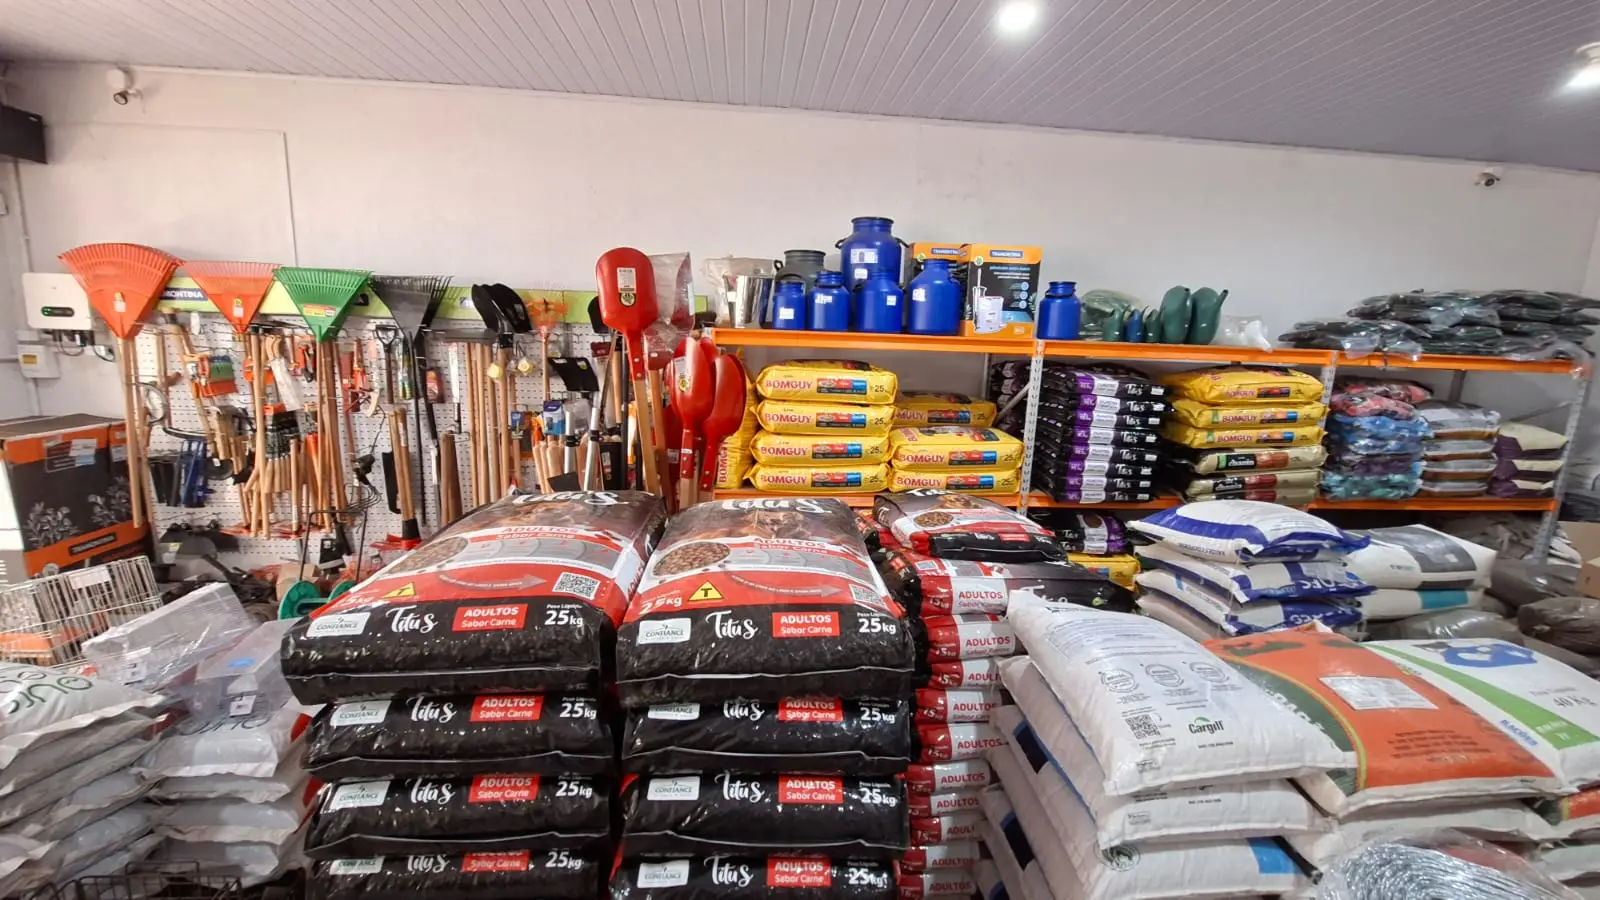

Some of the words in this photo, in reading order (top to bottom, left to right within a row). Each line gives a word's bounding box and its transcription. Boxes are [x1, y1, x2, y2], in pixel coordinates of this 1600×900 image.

[765, 379, 813, 390] BOMGUY
[764, 413, 812, 424] BOMGUY
[760, 446, 808, 456] BOMGUY
[901, 454, 945, 463] BOMGUY
[760, 474, 807, 485] BOMGUY
[896, 476, 942, 487] BOMGUY
[959, 591, 1003, 599] ADULTOS
[464, 607, 519, 617] ADULTOS
[385, 605, 438, 633] Titus
[544, 610, 583, 627] 25kg
[781, 615, 832, 624] ADULTOS
[461, 620, 489, 628] Sabor
[705, 610, 758, 639] Titus
[859, 618, 896, 634] 25kg
[781, 626, 806, 634] Sabor
[966, 636, 1010, 647] ADULTOS
[968, 673, 1000, 681] ADUL
[481, 698, 535, 707] ADULTOS
[786, 701, 835, 709] ADULTOS
[480, 710, 505, 718] Sabor
[507, 710, 532, 718] Carne
[560, 702, 597, 719] 25kg
[786, 711, 809, 719] Sabor
[812, 711, 836, 719] Carne
[860, 707, 896, 724] 25kg
[1188, 720, 1225, 735] Cargill
[957, 739, 1001, 749] ADULTOS
[480, 778, 532, 787] ADULTOS
[941, 773, 986, 784] ADULTOS
[555, 781, 593, 798] 25kg
[786, 780, 836, 790] ADULTOS
[477, 790, 503, 799] Sabor
[504, 789, 529, 798] Carne
[786, 792, 810, 800] Sabor
[812, 792, 836, 800] Carne
[937, 797, 980, 808] ADULTOS
[946, 825, 975, 835] ADUL
[703, 854, 753, 887] Titus
[775, 862, 824, 871] ADULTOS
[775, 874, 799, 883] Sabor
[800, 875, 825, 883] Carne
[929, 881, 972, 892] ADULTOS
